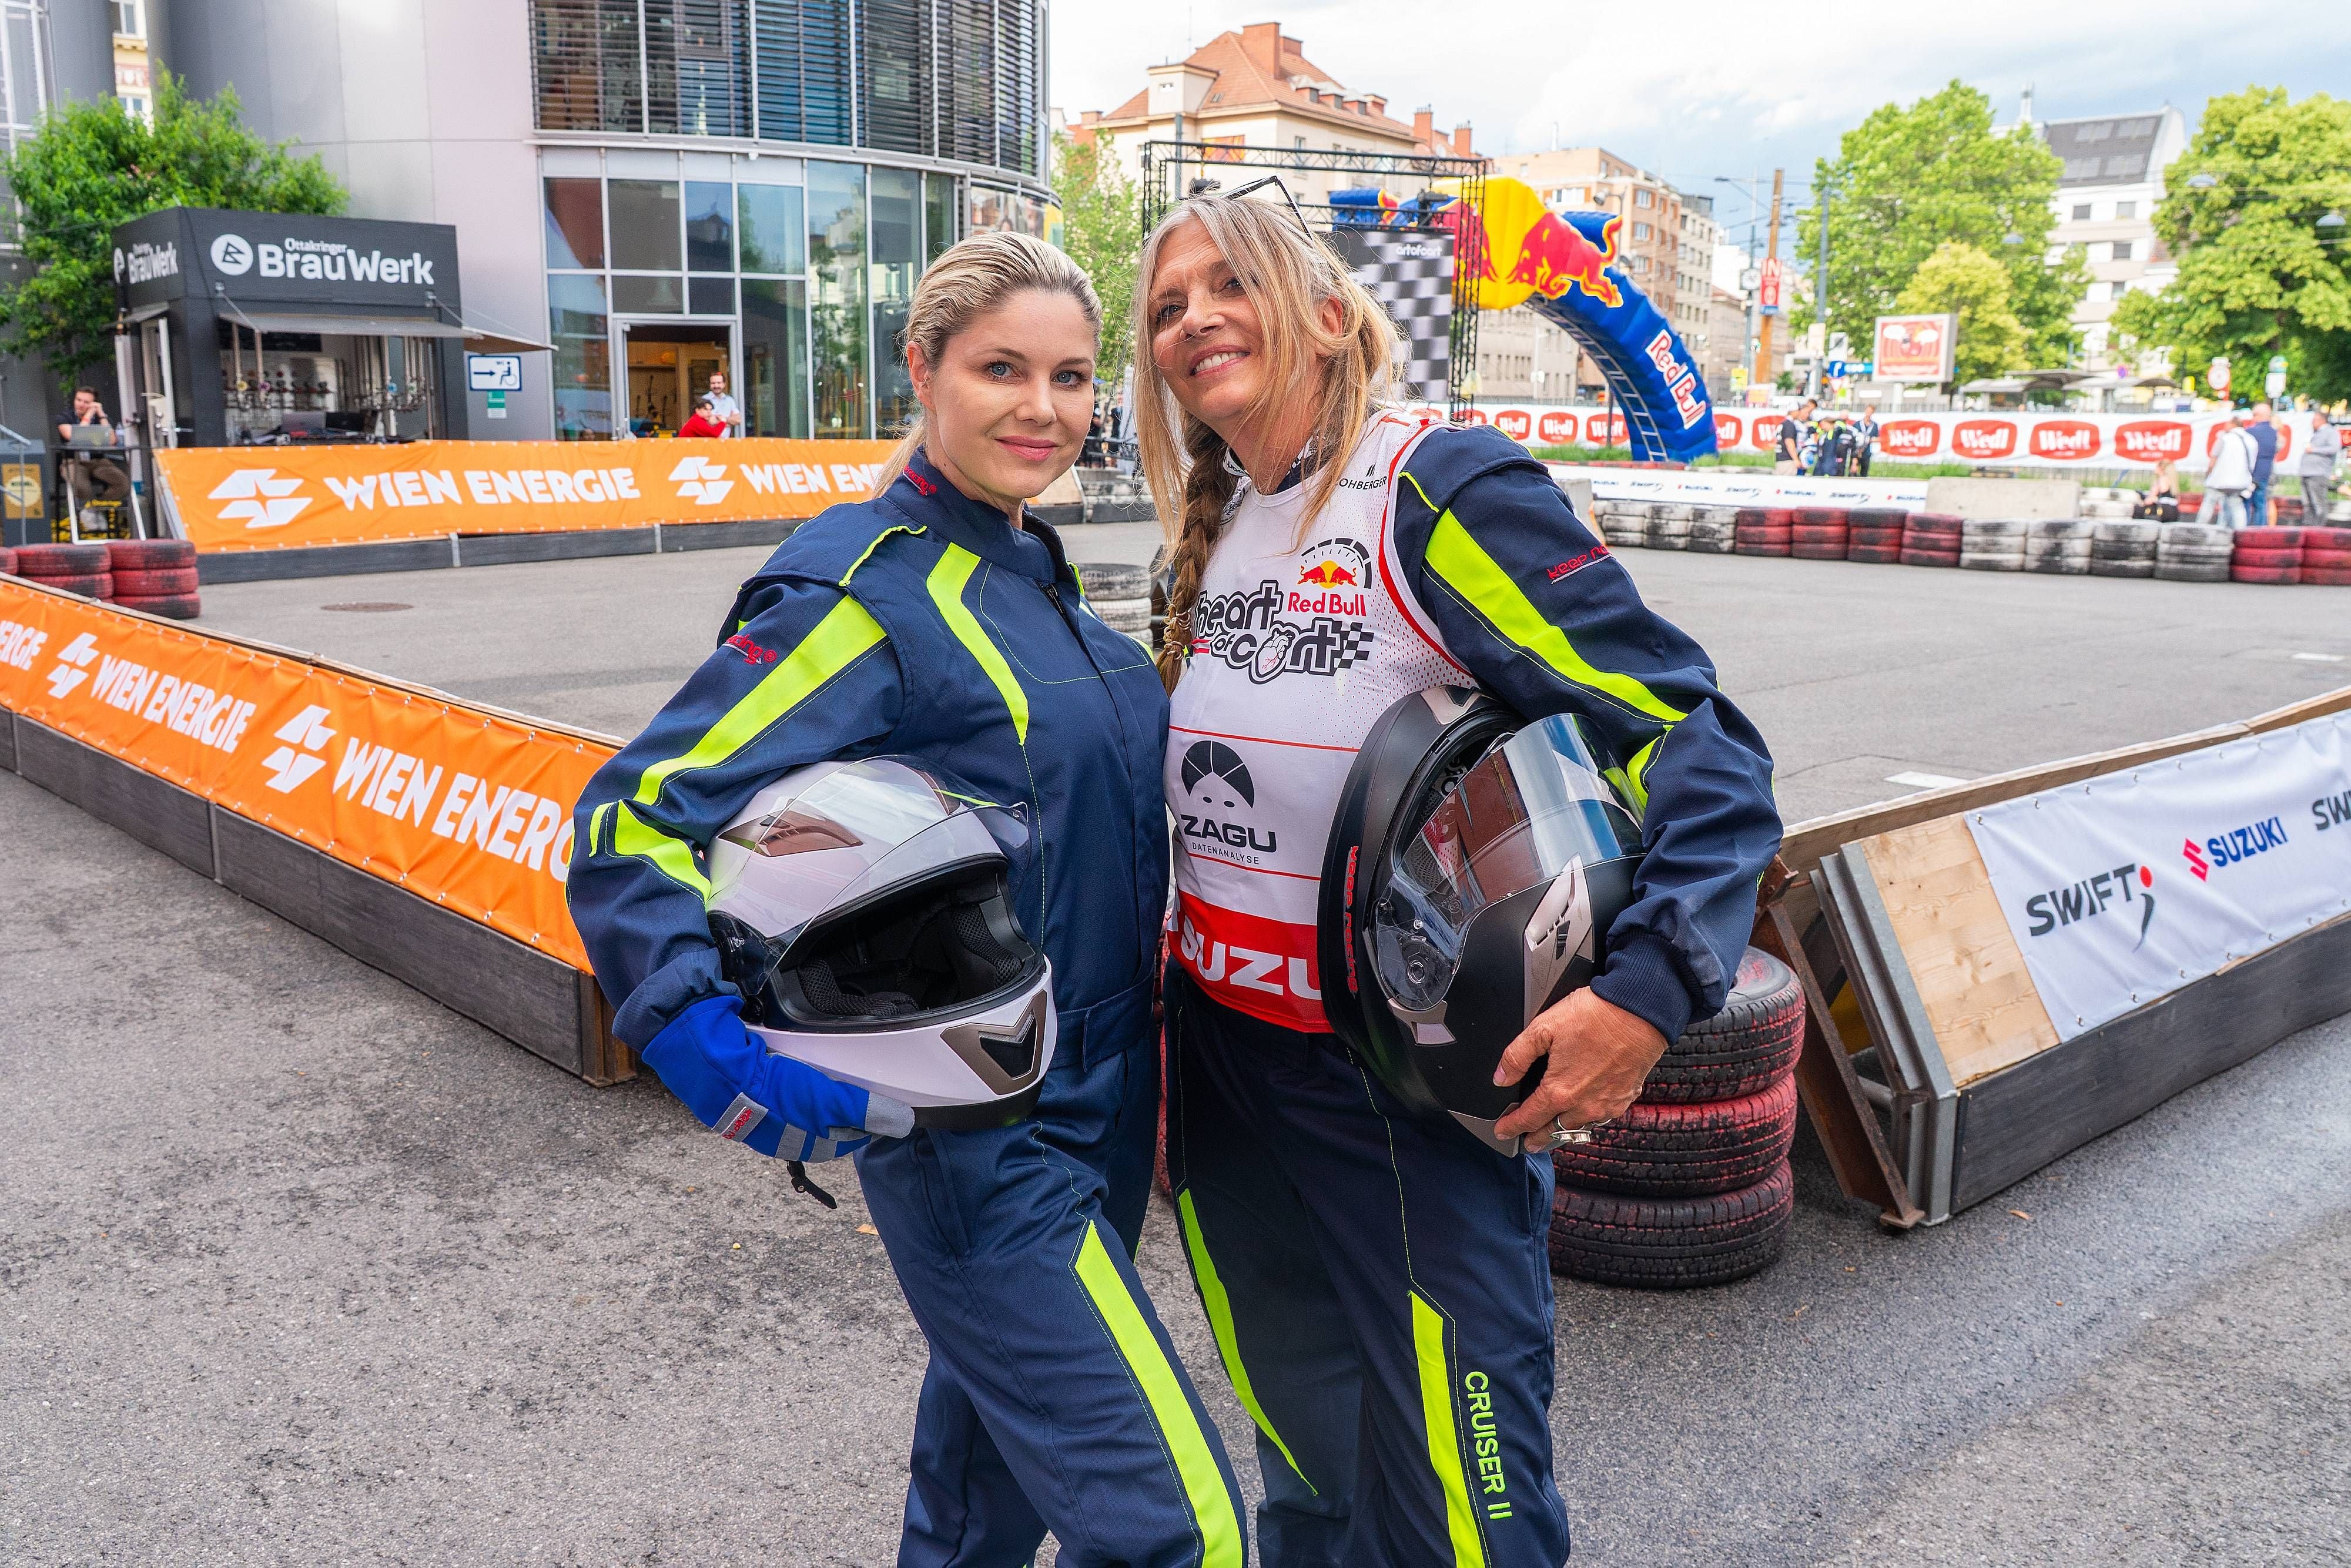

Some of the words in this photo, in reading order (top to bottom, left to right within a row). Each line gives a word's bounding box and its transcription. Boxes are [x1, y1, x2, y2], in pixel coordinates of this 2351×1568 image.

[257, 243, 435, 286] BrauWerk
[1646, 330, 1687, 386] Red
[1671, 374, 1706, 428] Bull
[1543, 419, 1573, 436] Wedl
[1590, 421, 1623, 438] Wdl
[1717, 421, 1736, 440] edl
[1888, 427, 1933, 447] Wedl
[1960, 428, 2010, 449] Wedl
[2038, 430, 2091, 451] Wedl
[2123, 429, 2182, 451] Wedl
[324, 470, 463, 511] WIEN
[464, 467, 641, 505] ENERGIE
[739, 463, 832, 494] WIEN
[1339, 475, 1388, 490] OHBERGER
[1546, 554, 1588, 579] keep
[1195, 585, 1279, 635] heart
[1287, 592, 1326, 614] Red
[1328, 593, 1367, 617] Bull
[0, 621, 48, 671] ERGIE
[1215, 634, 1234, 652] of
[91, 654, 159, 716] WIEN
[143, 674, 256, 753] ENERGIE
[333, 736, 444, 828] WIEN
[1180, 814, 1277, 853] ZAGU
[1192, 842, 1259, 865] DATENANALYSE
[2025, 863, 2136, 937] SWIFT
[2206, 816, 2288, 867] SUZUKI
[2312, 790, 2351, 830] SW
[1346, 846, 1359, 907] keep
[1181, 915, 1322, 1000] SUZU
[1344, 912, 1358, 994] racing
[1465, 1371, 1506, 1495] CRUISER
[1487, 1502, 1513, 1520] II
